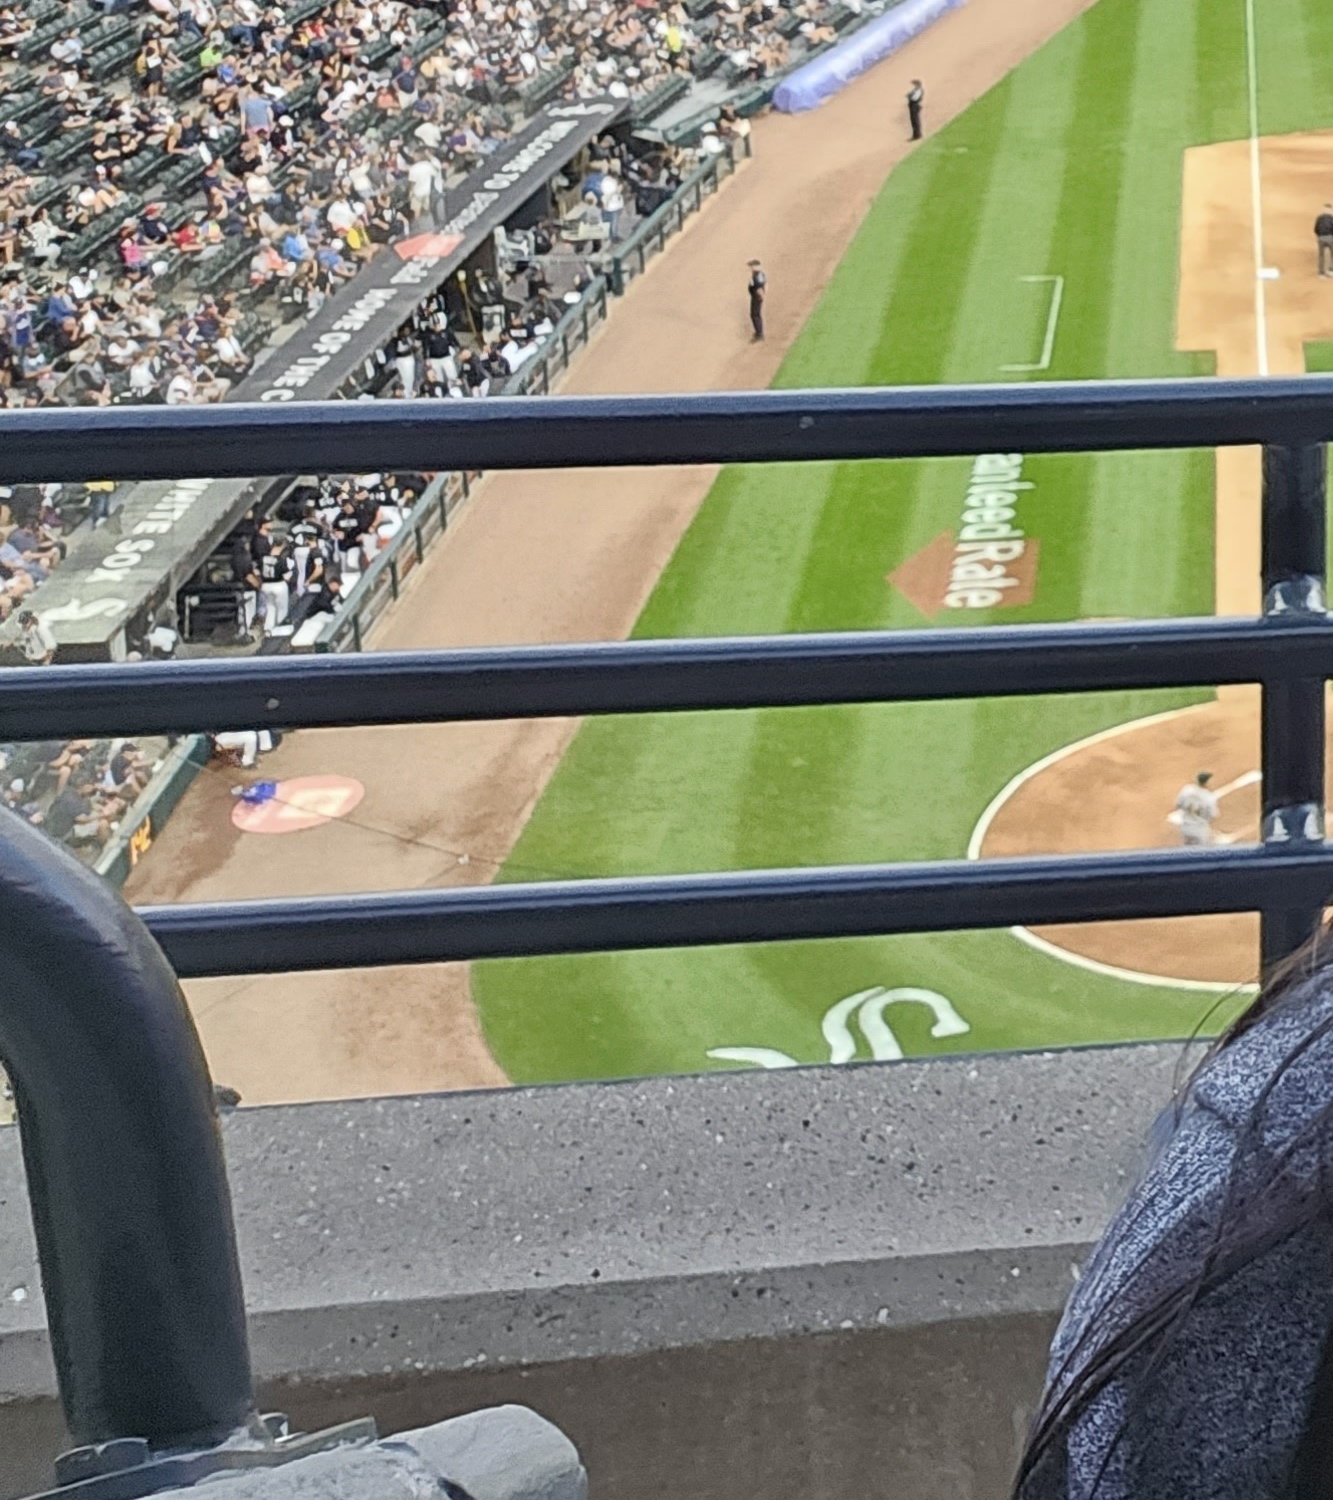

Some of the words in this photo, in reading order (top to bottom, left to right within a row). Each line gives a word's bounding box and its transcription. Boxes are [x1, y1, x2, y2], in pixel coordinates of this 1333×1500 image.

[312, 332, 352, 354] OF
[85, 538, 155, 583] SOX
[943, 538, 1026, 610] Rate
